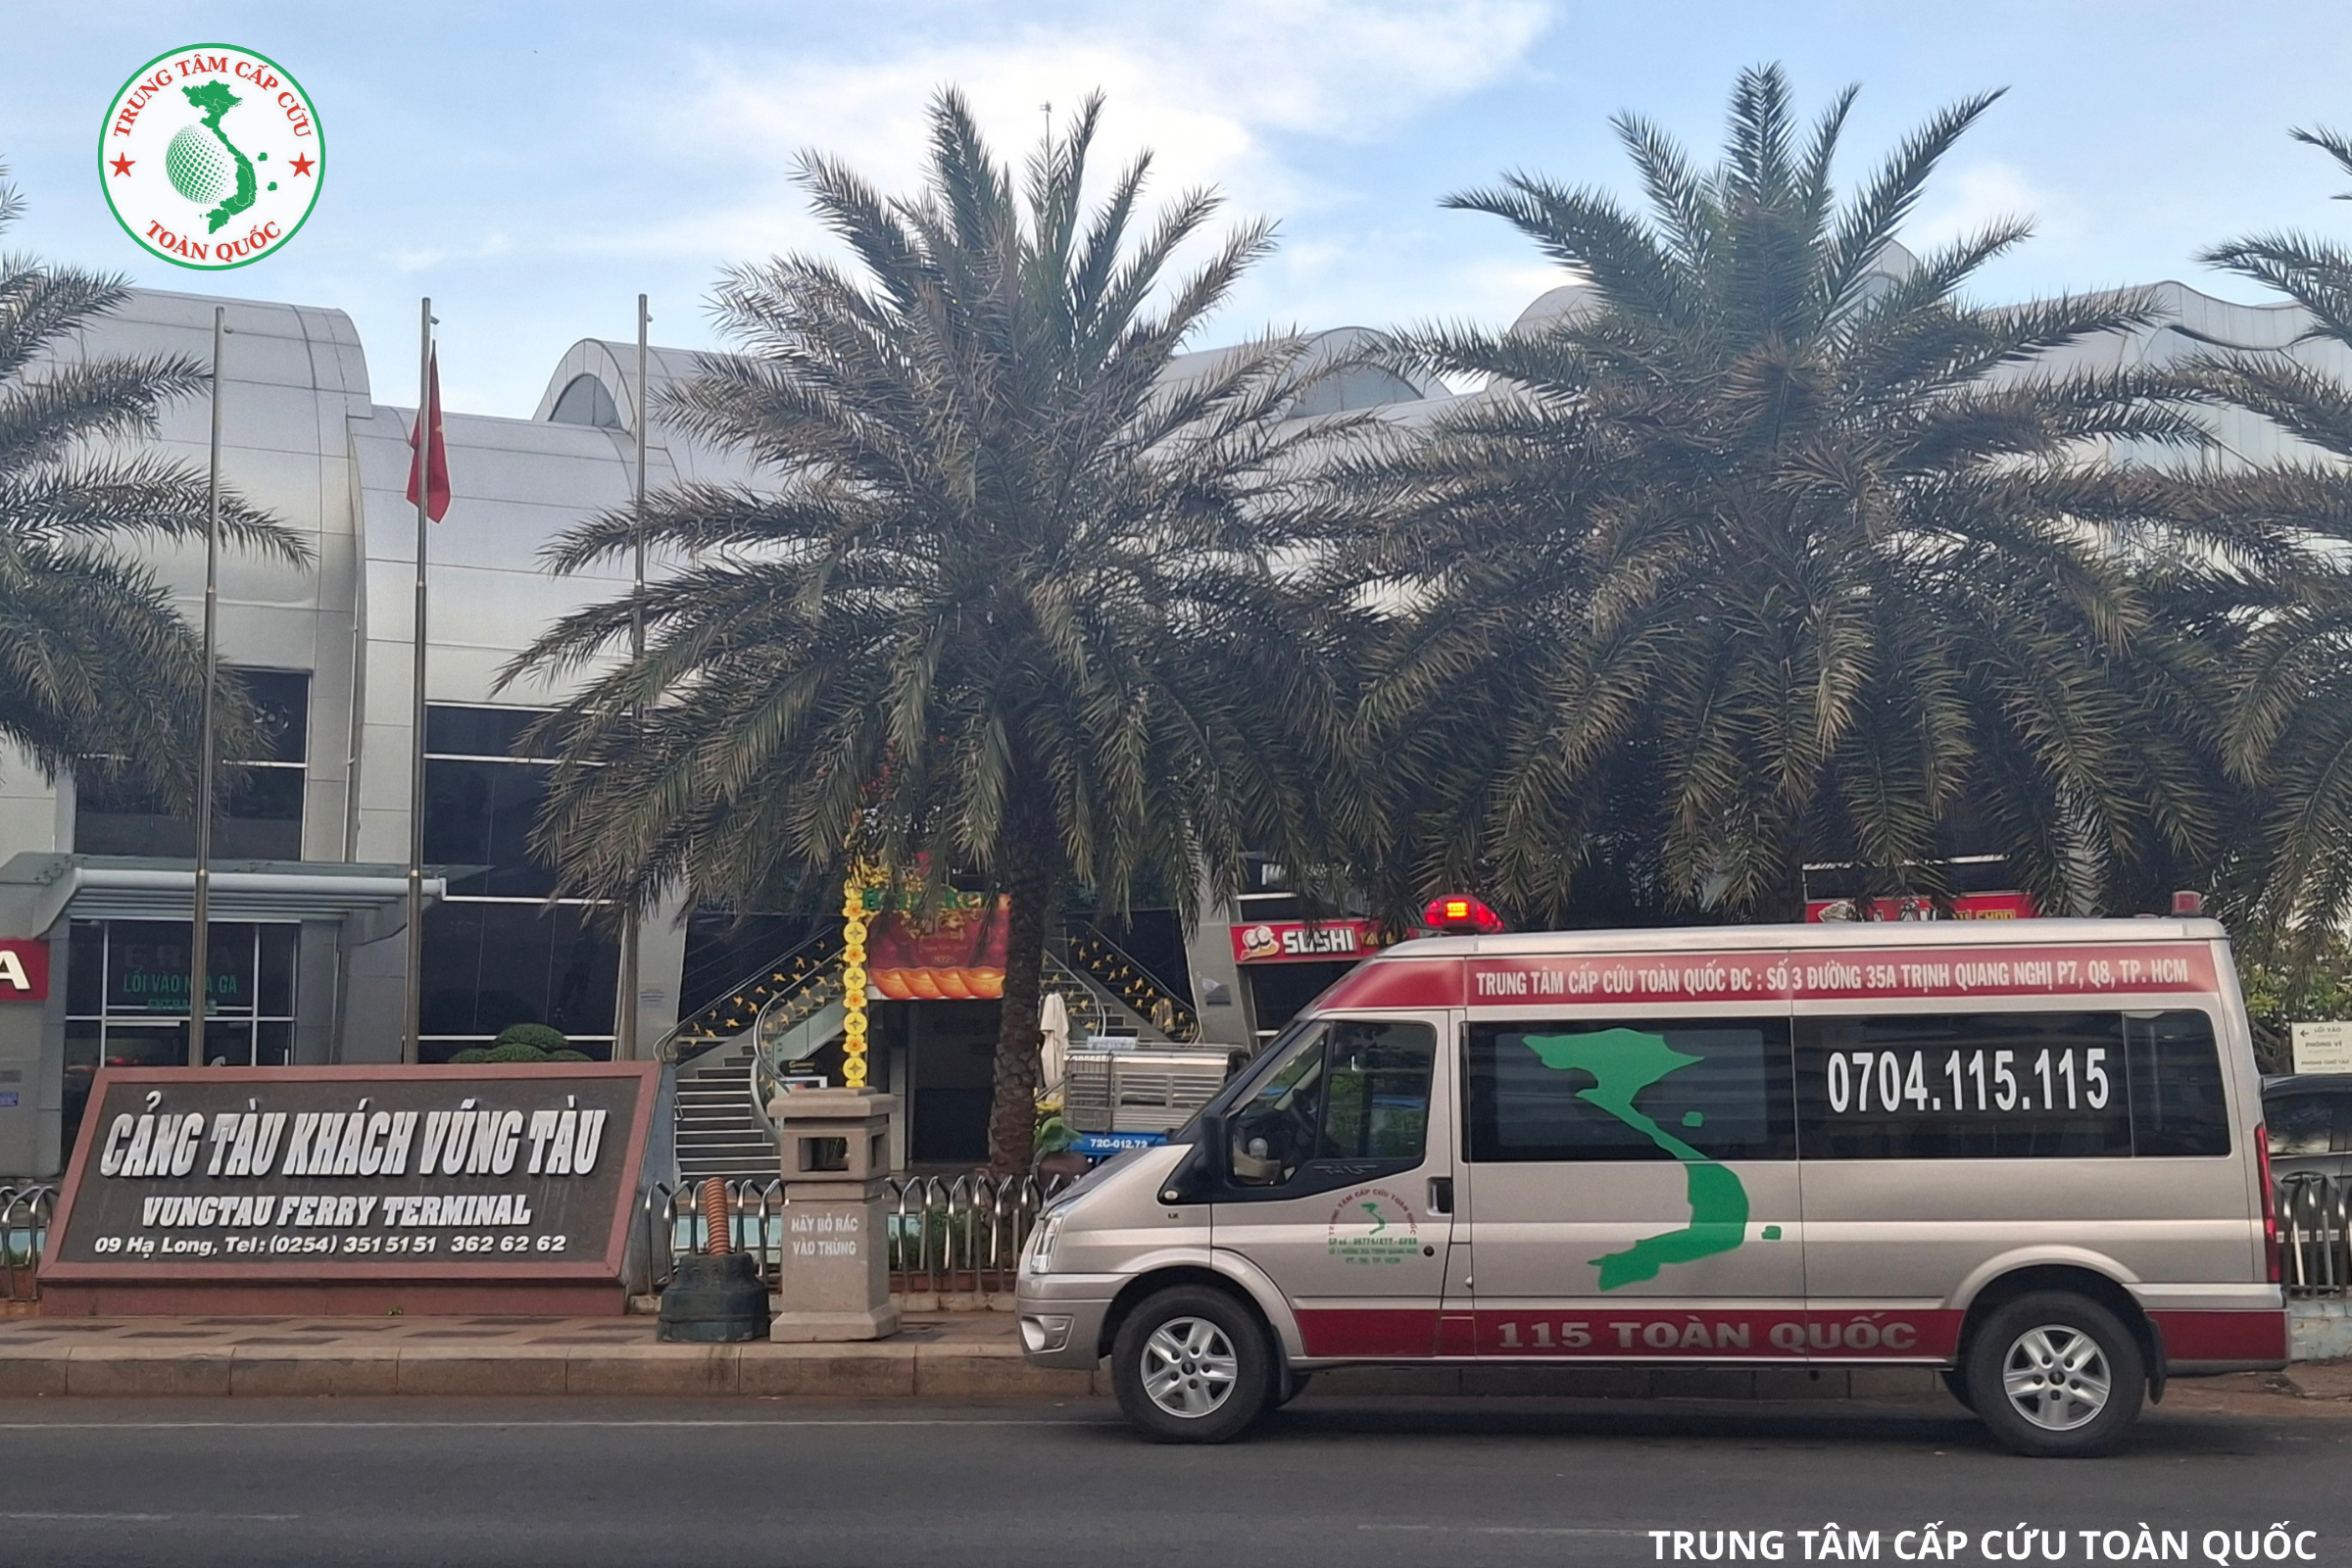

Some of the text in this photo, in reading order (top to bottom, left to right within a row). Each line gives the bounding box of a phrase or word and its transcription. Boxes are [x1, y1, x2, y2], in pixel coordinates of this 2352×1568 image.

[1282, 928, 1355, 954] SUSHI
[123, 967, 237, 994] LỐI VÀO NÀ GA
[1476, 972, 1527, 996] TRUNG
[1531, 966, 1564, 994] TÂM
[1568, 962, 1598, 994] CẤP
[1603, 963, 1634, 993] CỨU
[1638, 963, 1679, 993] TOÀN
[1684, 959, 1726, 996] QUỐC
[1766, 957, 1788, 991] SỐ
[1791, 966, 1802, 990] 3
[1807, 959, 1862, 990] ĐƯỜNG
[1866, 964, 1897, 989] 35A
[1900, 963, 1950, 993] TRỊNH
[1955, 962, 2009, 991] QUANG
[2014, 961, 2053, 991] NGHỊ
[2057, 960, 2084, 989] P7,
[2087, 960, 2115, 989] Q8,
[2119, 959, 2146, 983] TP.
[2151, 958, 2188, 983] HCM
[1828, 1048, 2109, 1112] 0704.115.115
[100, 1090, 607, 1176] CẢNG TÀU KHÁCH VŨNG TÀU
[1090, 1138, 1149, 1149] 72C-012.72
[142, 1195, 532, 1226] VUNGTAU FERRY TERMINAL
[791, 1212, 858, 1232] HÃY BỎ RÁC
[94, 1237, 122, 1253] 09
[125, 1237, 155, 1259] Hạ
[161, 1237, 219, 1256] Long,
[451, 1236, 494, 1252] 362
[500, 1236, 529, 1252] 62
[536, 1235, 566, 1252] 62
[793, 1237, 857, 1255] VÀO THÙNG
[1497, 1312, 1917, 1353] 115 TOÀN QUỐC
